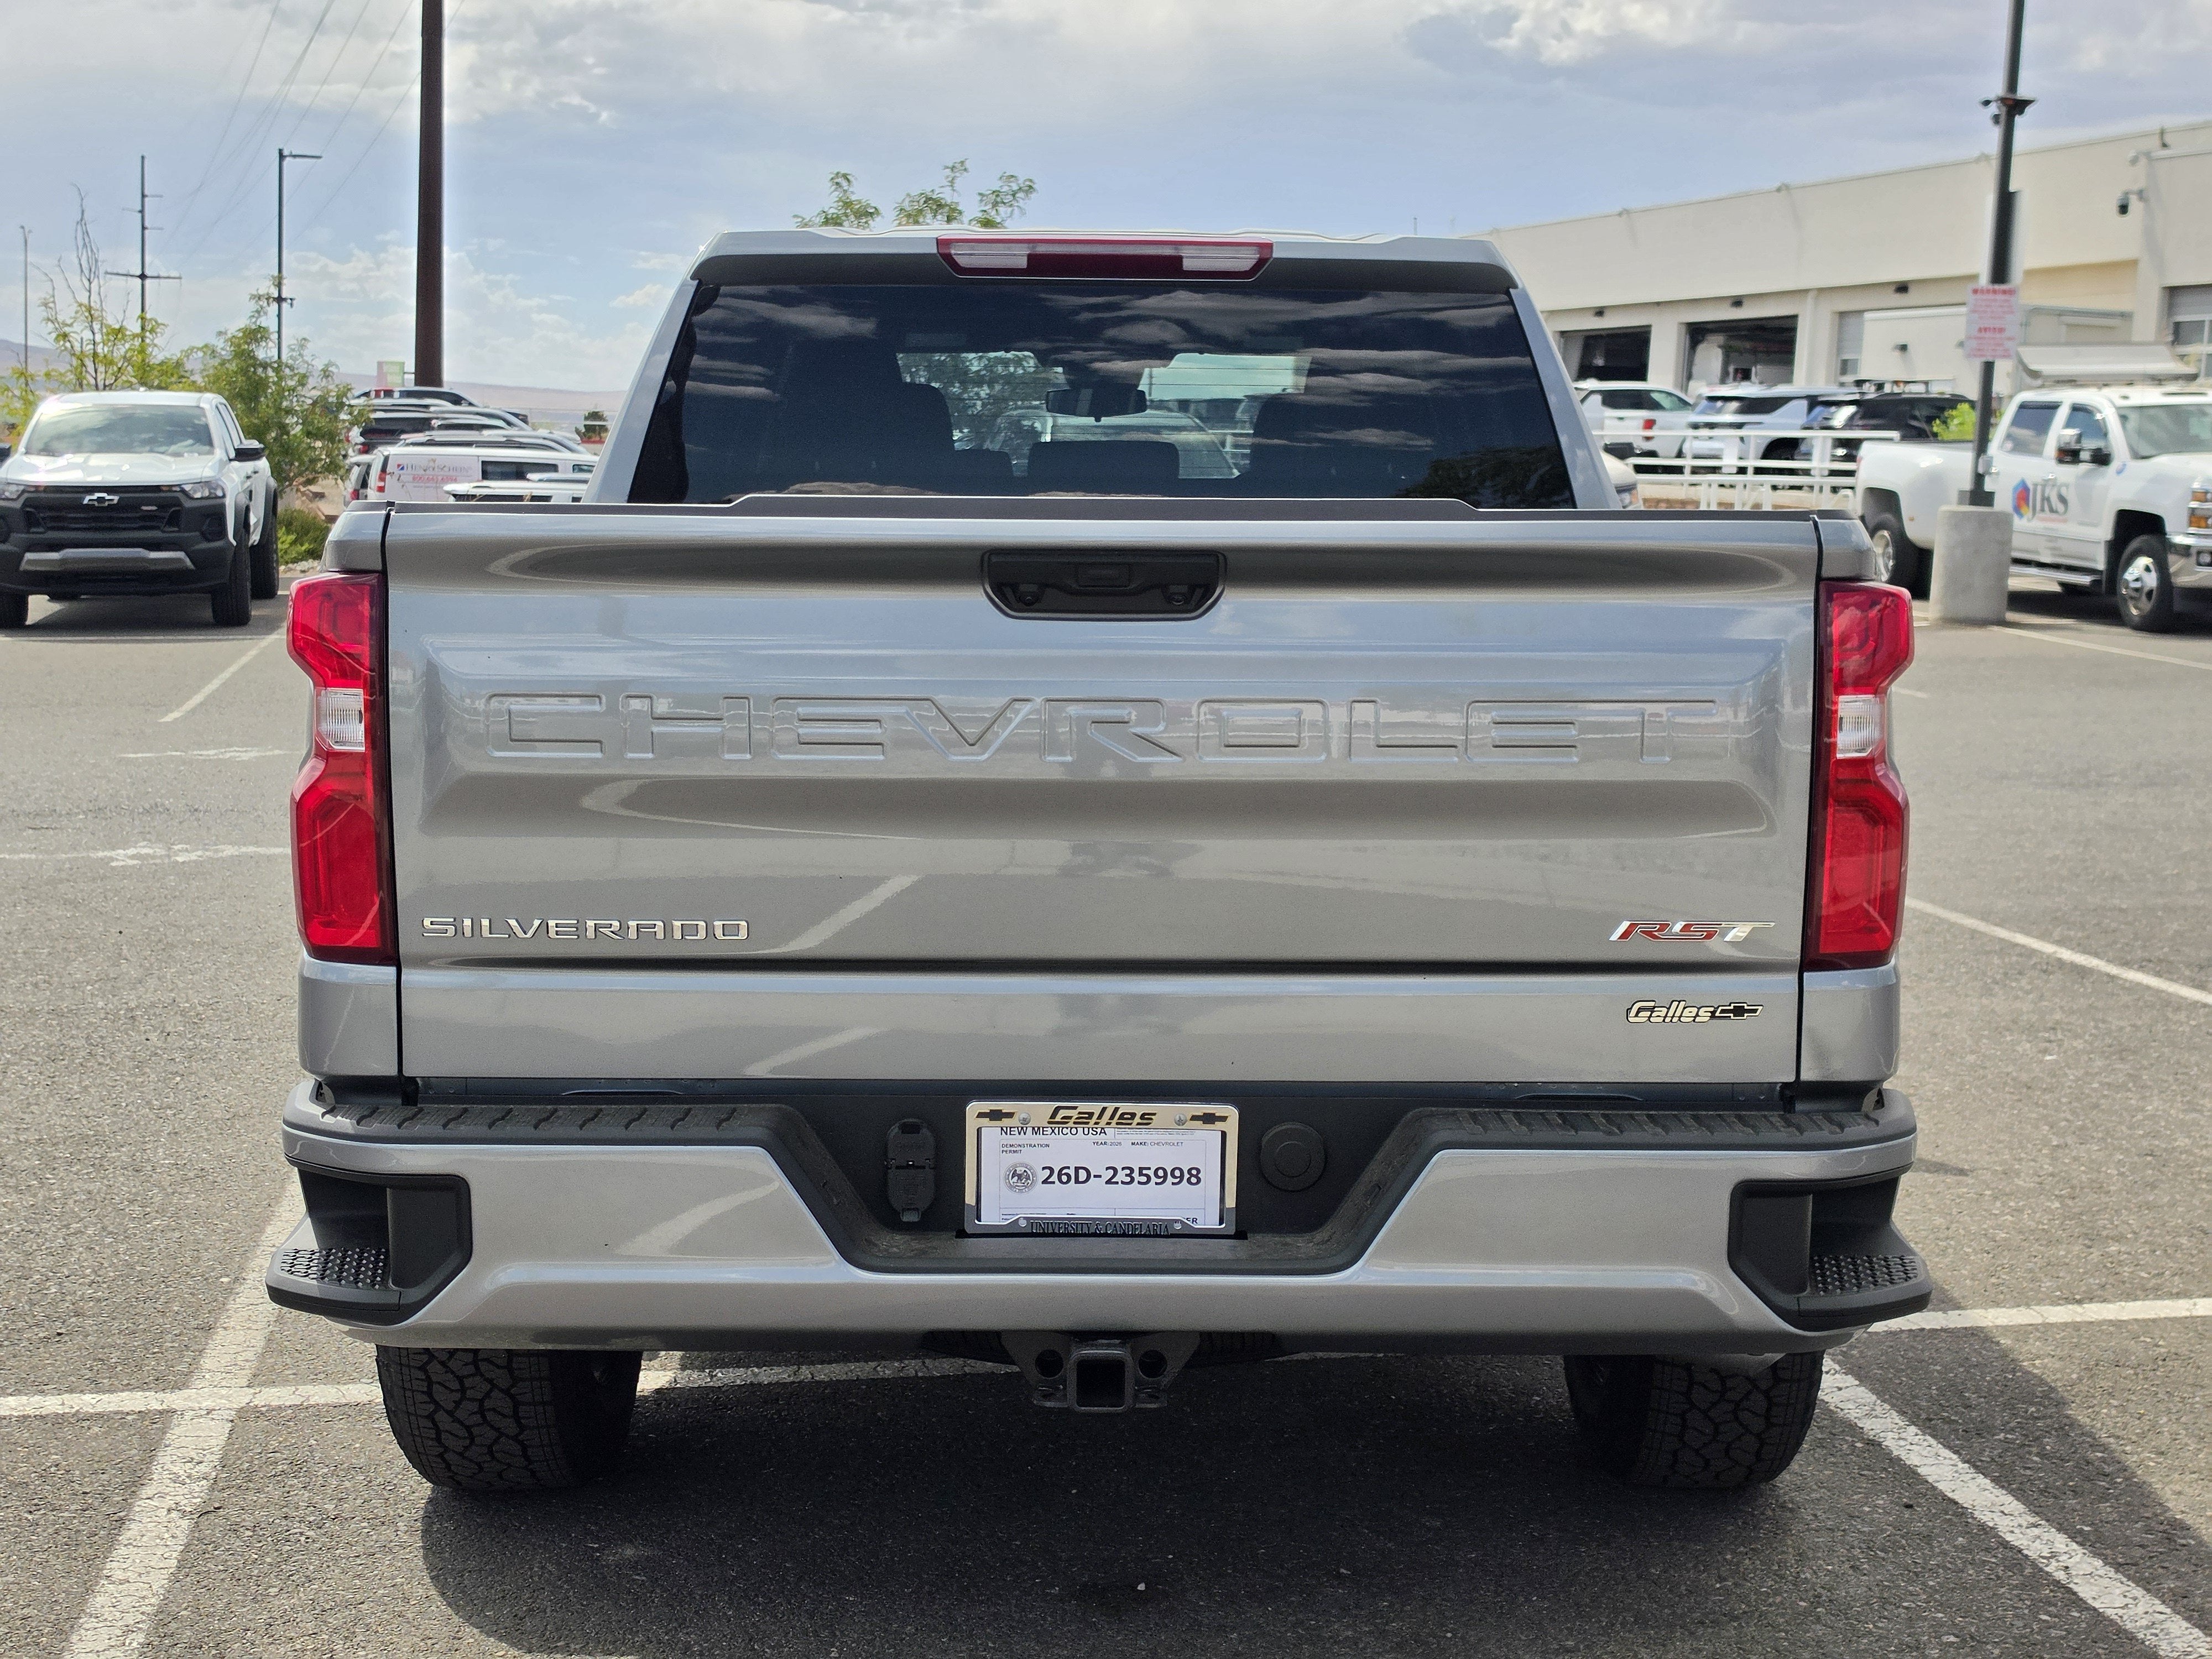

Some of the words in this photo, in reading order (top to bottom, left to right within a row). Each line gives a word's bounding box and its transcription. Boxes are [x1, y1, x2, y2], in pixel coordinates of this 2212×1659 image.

[2027, 479, 2069, 522] JKS
[483, 693, 1718, 764] CHEVROLET
[421, 917, 750, 941] SILVERADO
[1609, 920, 1776, 942] RST
[1627, 1000, 1715, 1023] Galles
[1047, 1105, 1157, 1126] Galles
[1000, 1126, 1027, 1136] NEW
[1032, 1127, 1078, 1136] MEXICO
[1082, 1128, 1107, 1136] USA
[1041, 1166, 1202, 1186] 26D-235998
[1030, 1220, 1093, 1234] UNIVERSITY
[1094, 1221, 1103, 1234] &
[1106, 1222, 1171, 1235] CANDELARIA
